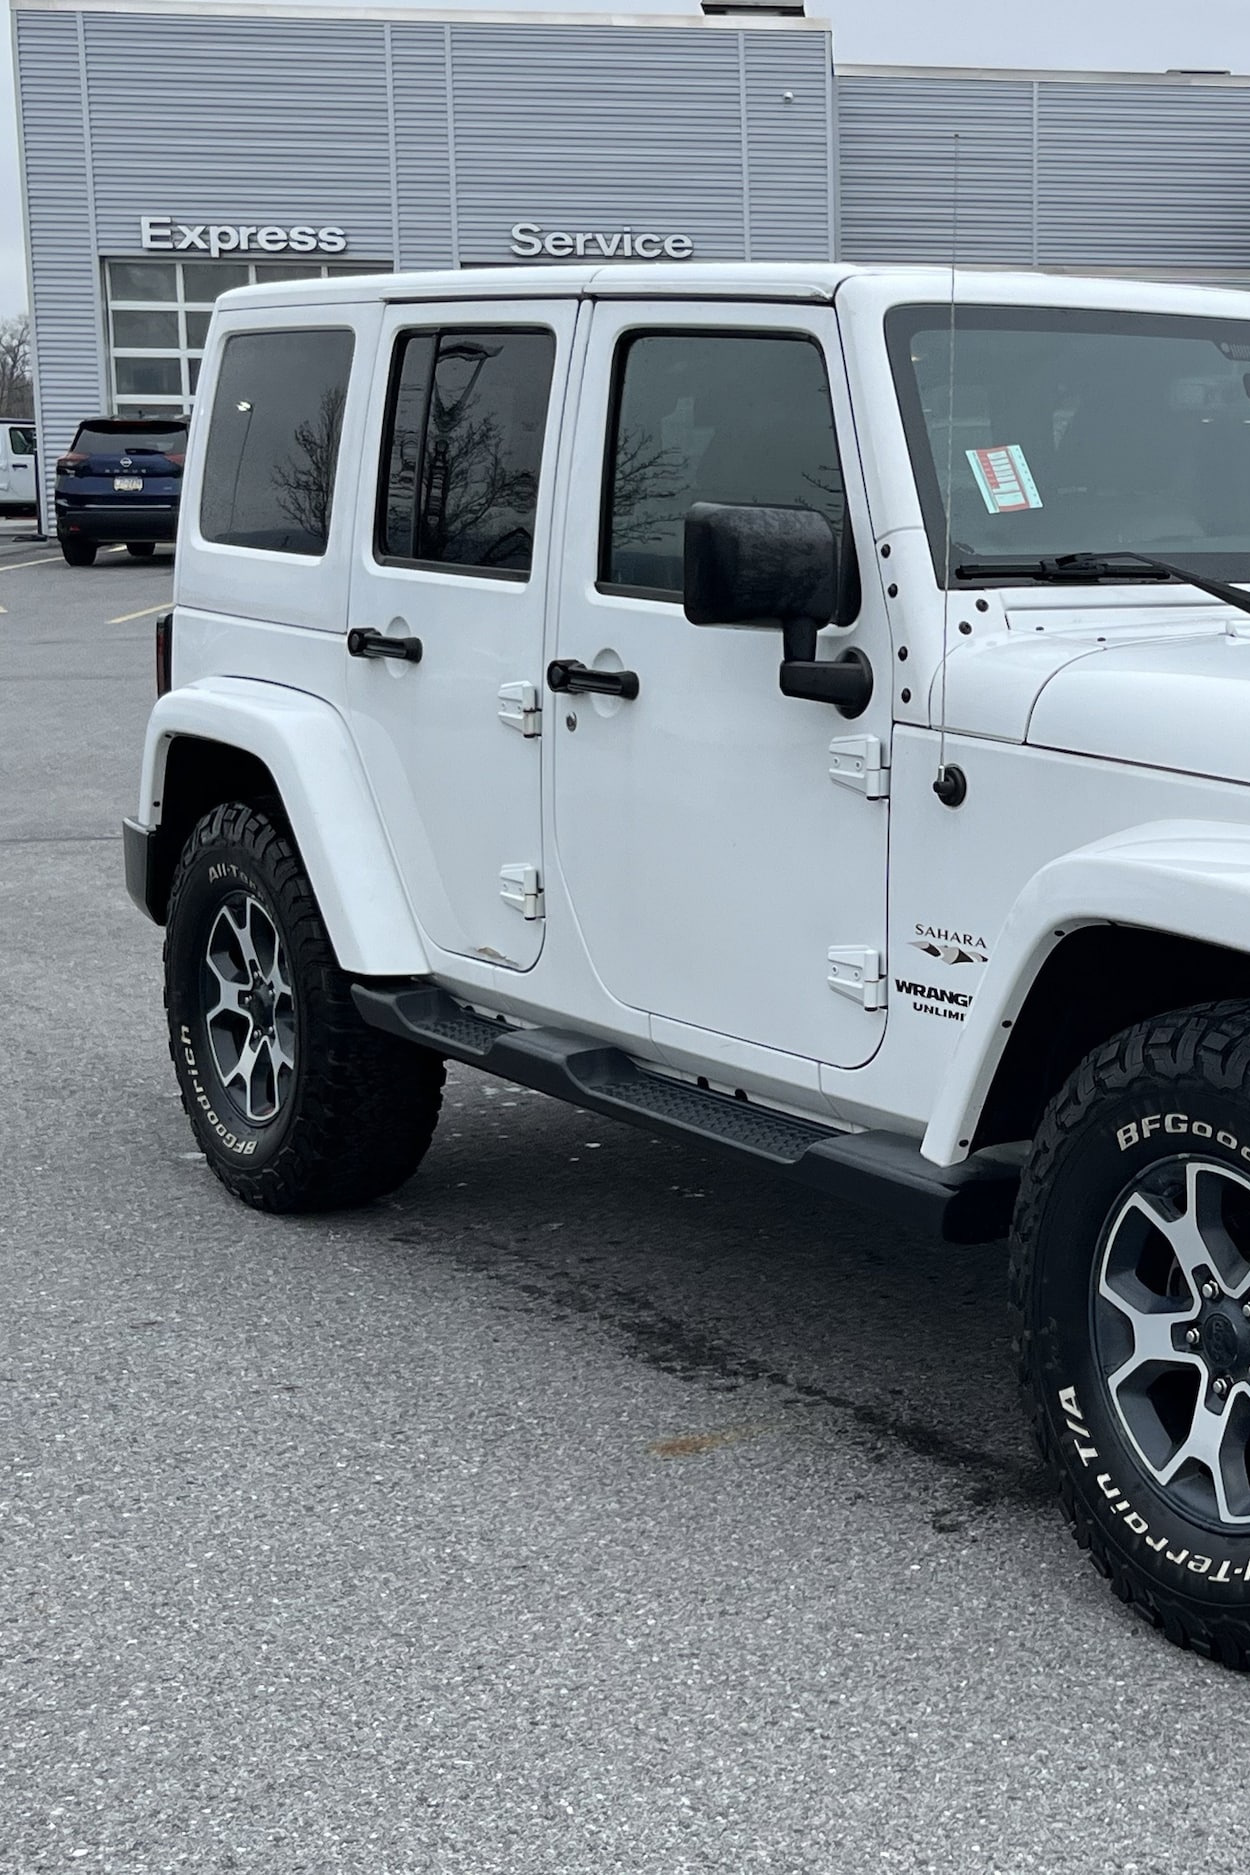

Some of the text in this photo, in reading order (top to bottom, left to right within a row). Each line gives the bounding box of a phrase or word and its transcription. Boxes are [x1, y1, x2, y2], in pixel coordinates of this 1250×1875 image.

[140, 215, 347, 259] Express
[510, 222, 694, 259] Service
[915, 923, 987, 949] SAHARA
[895, 978, 973, 1008] WRANG
[181, 1024, 258, 1155] BFGoodrich
[1058, 1384, 1099, 1468] T/A
